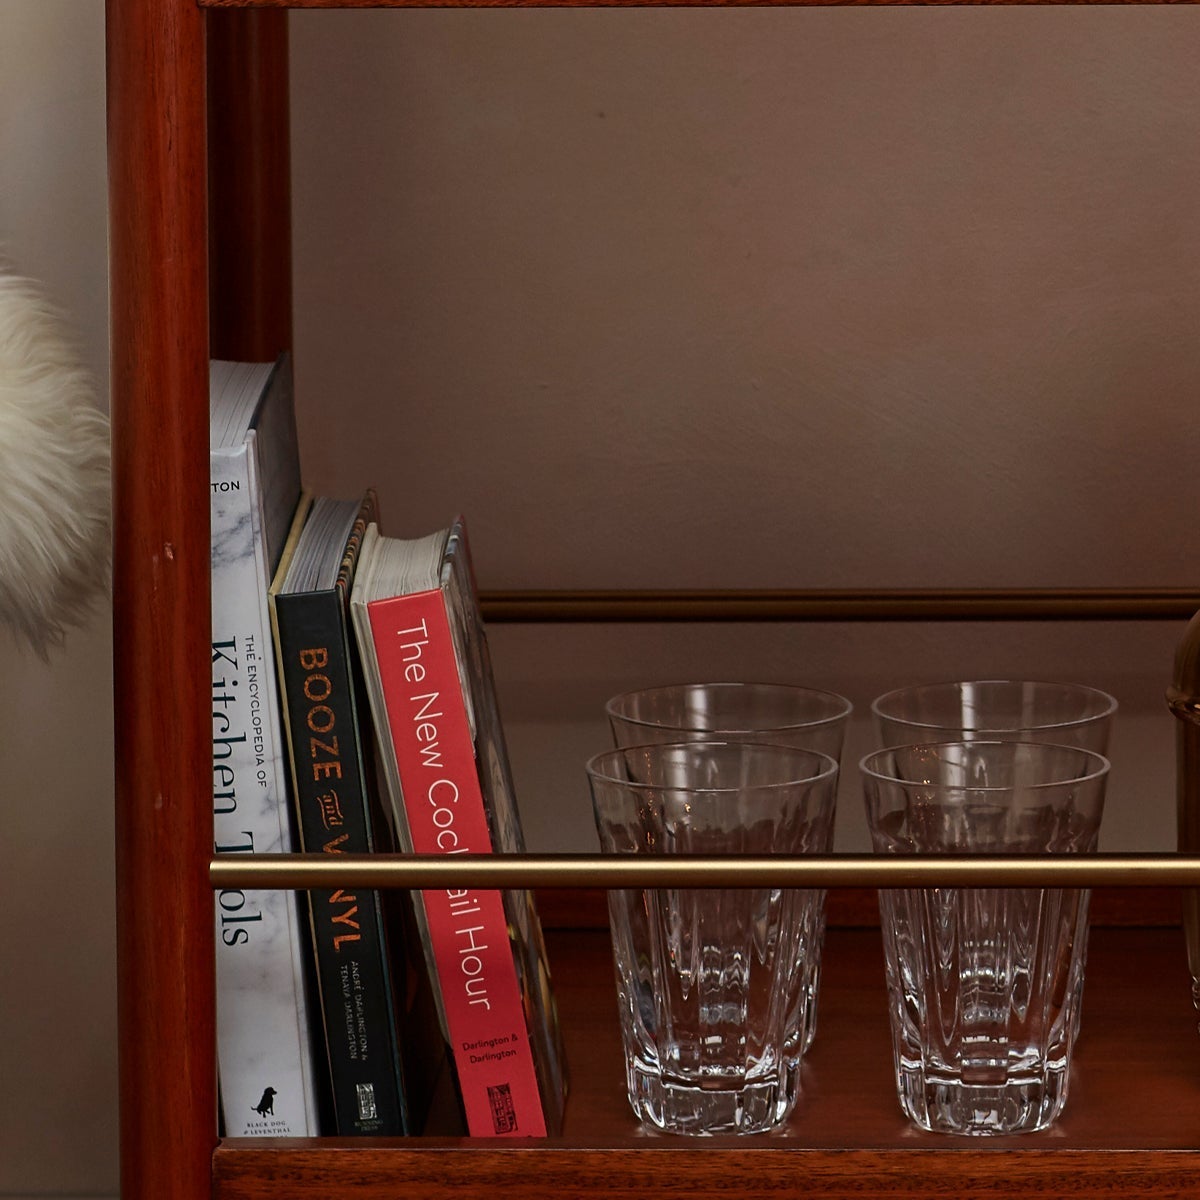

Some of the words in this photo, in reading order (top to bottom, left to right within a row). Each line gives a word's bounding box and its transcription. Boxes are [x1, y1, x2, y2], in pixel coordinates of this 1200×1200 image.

[211, 480, 240, 493] TON
[244, 634, 257, 661] THE
[397, 618, 430, 683] The
[212, 636, 247, 815] Kitchen
[247, 664, 266, 767] ENCYCLOPEDIA
[410, 695, 445, 768] New
[256, 769, 267, 788] OF
[299, 646, 344, 782] BOOZE
[322, 832, 362, 953] VNYL
[455, 925, 491, 1011] Hour
[354, 993, 368, 1053] DARLINGTON
[462, 1036, 510, 1051] Darlington
[511, 1033, 518, 1041] &
[469, 1049, 517, 1064] Darlington
[250, 1127, 291, 1135] LEVENTHAL
